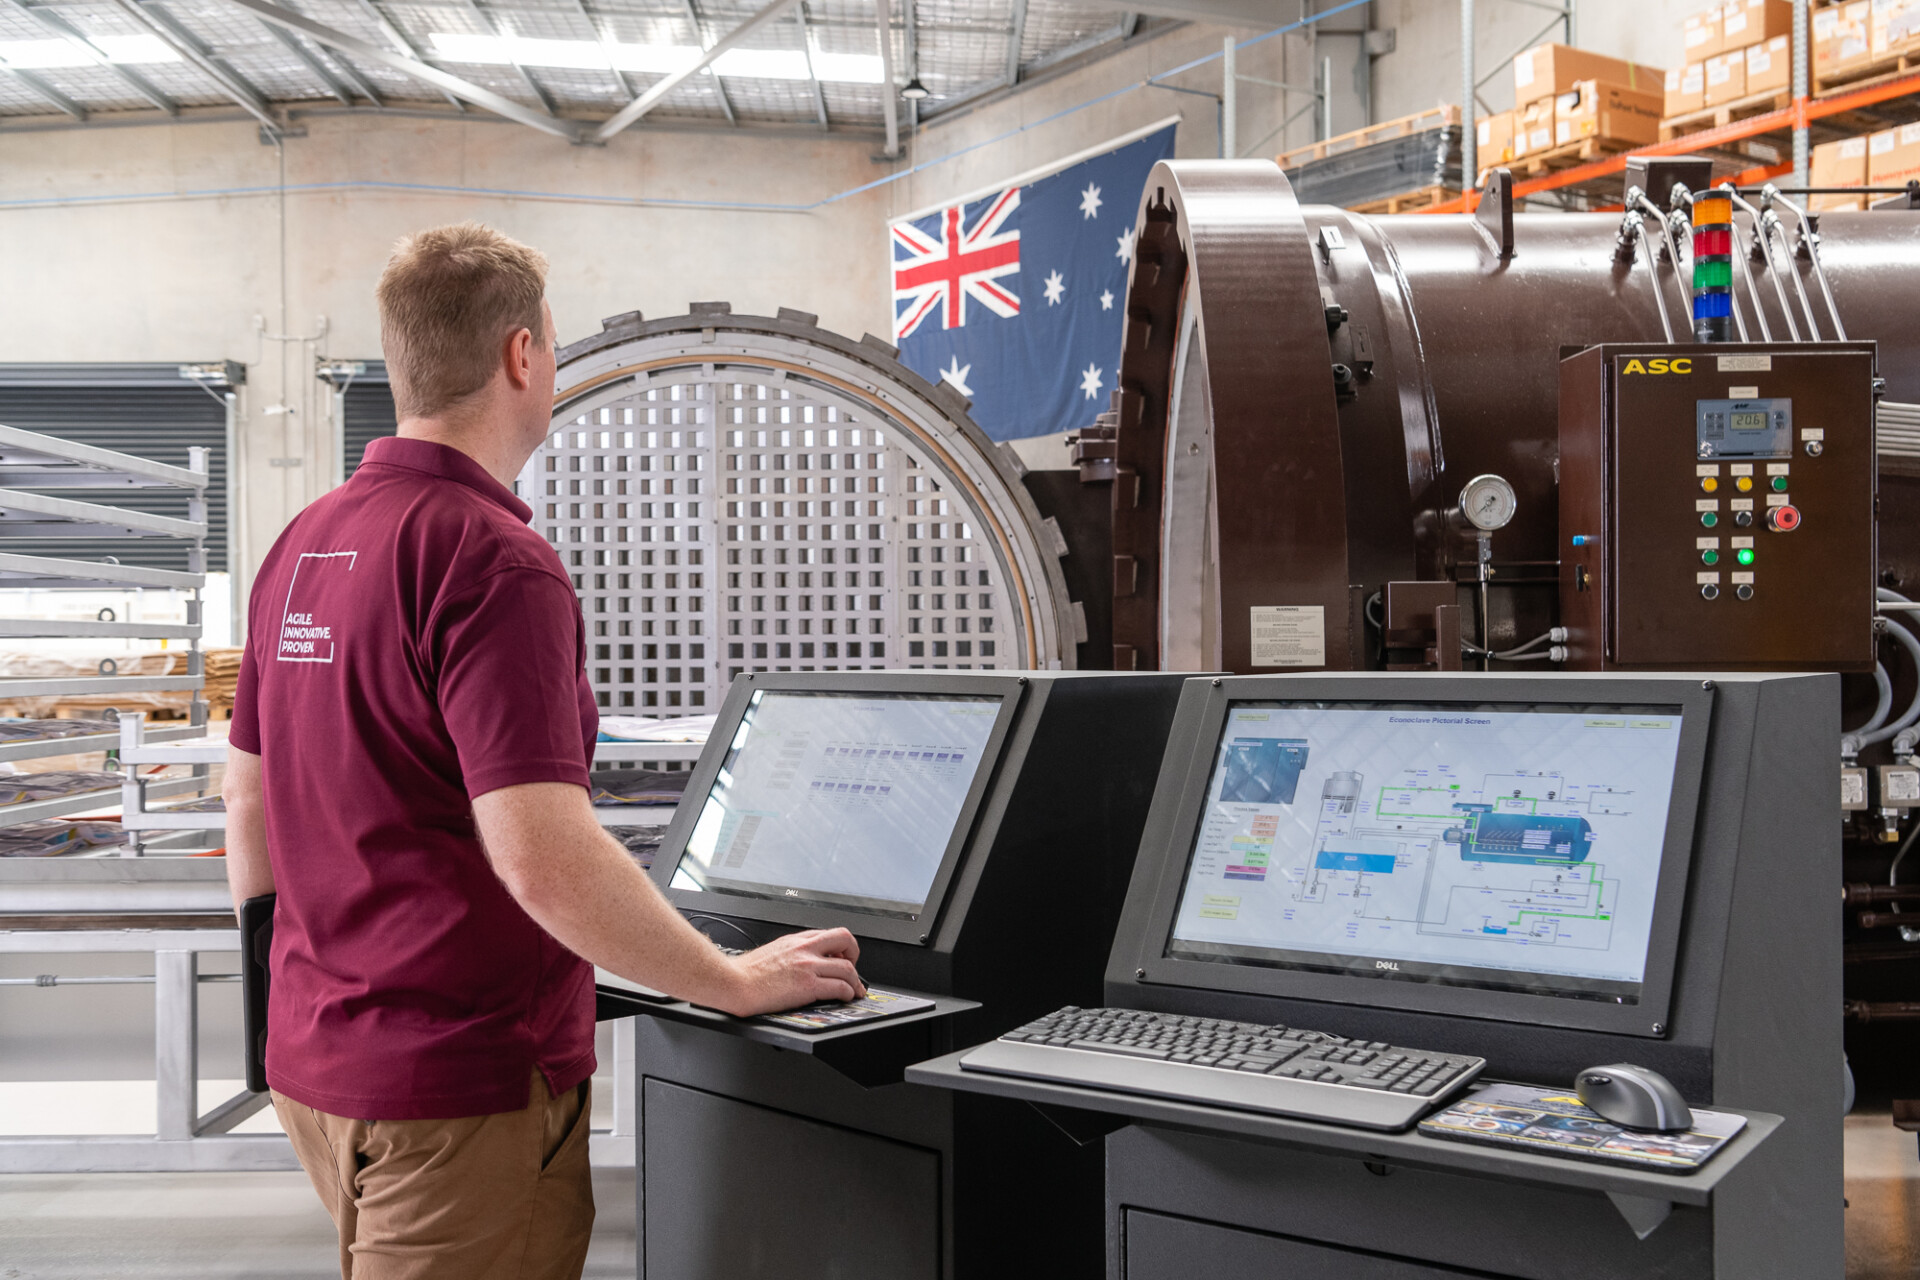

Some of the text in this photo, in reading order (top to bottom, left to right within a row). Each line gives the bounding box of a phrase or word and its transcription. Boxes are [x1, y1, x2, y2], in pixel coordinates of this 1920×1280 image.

[1622, 358, 1692, 375] ASC
[286, 613, 313, 625] AGILE.
[284, 627, 332, 639] INNOVATIVE.
[281, 641, 315, 653] PROVEN.
[1388, 716, 1431, 724] Econoclave
[785, 889, 799, 897] DELL
[1376, 960, 1400, 971] DELL
